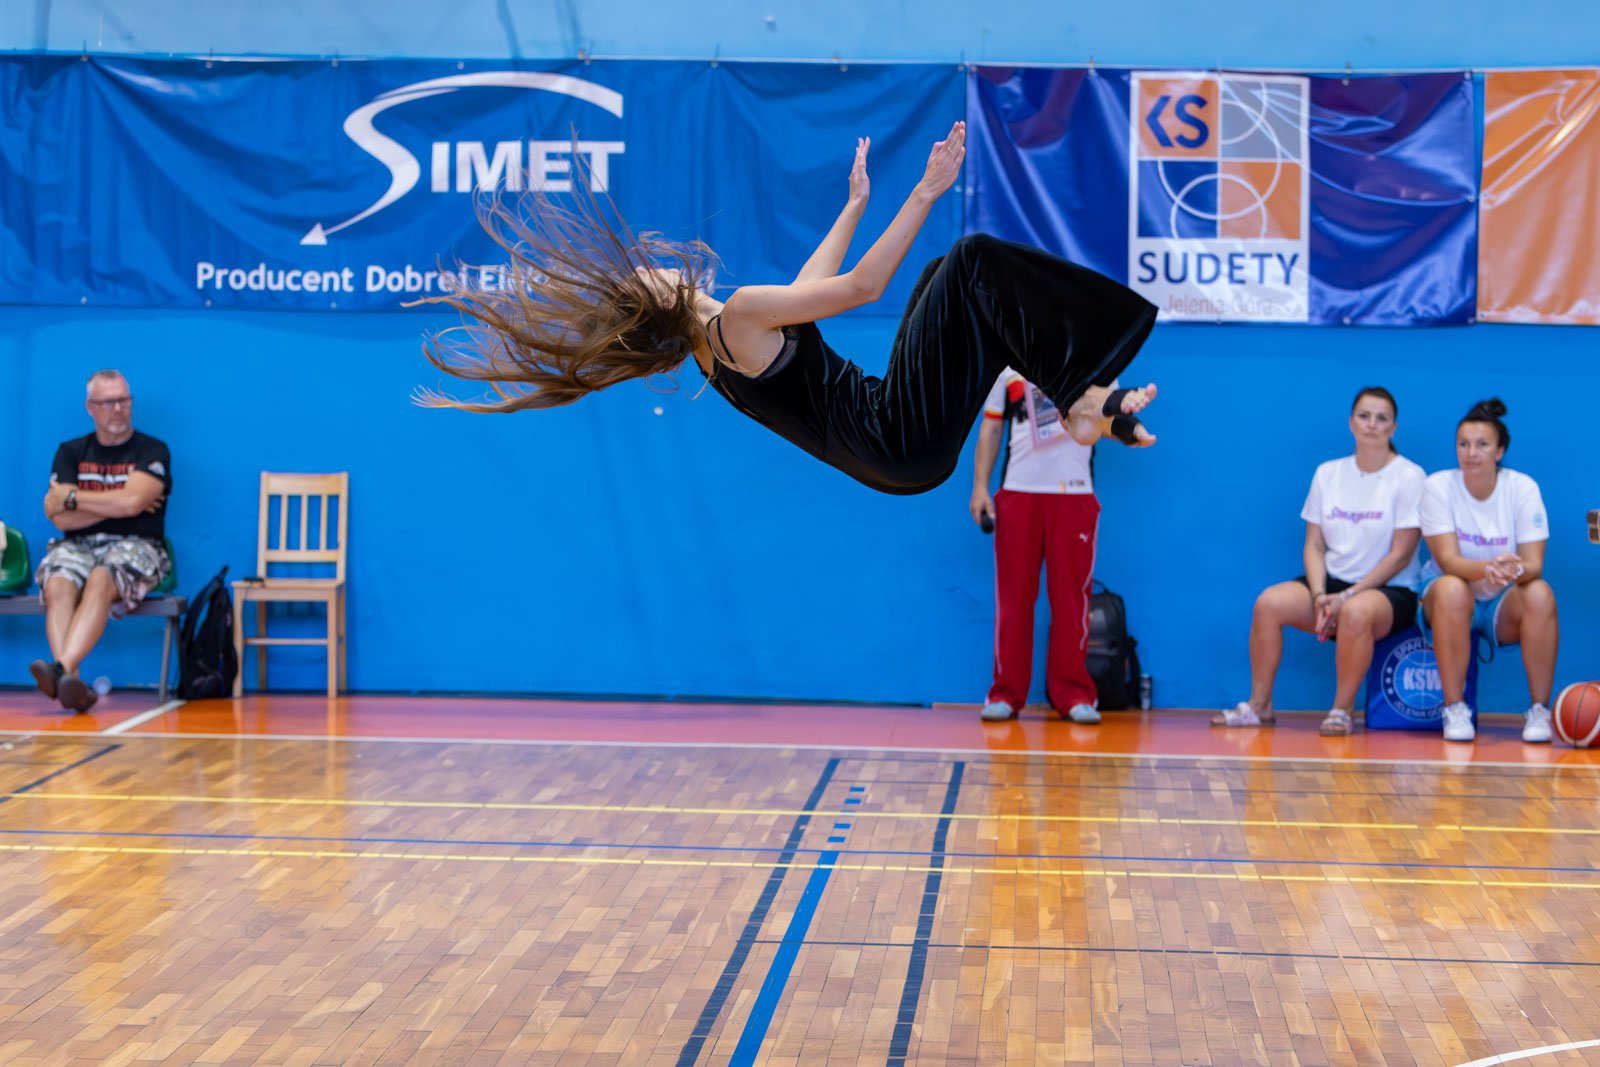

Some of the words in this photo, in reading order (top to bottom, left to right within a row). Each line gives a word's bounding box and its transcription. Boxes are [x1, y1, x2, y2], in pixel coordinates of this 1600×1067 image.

[301, 71, 625, 246] SIMET
[197, 262, 354, 293] Producent
[1137, 251, 1299, 286] SUDETY
